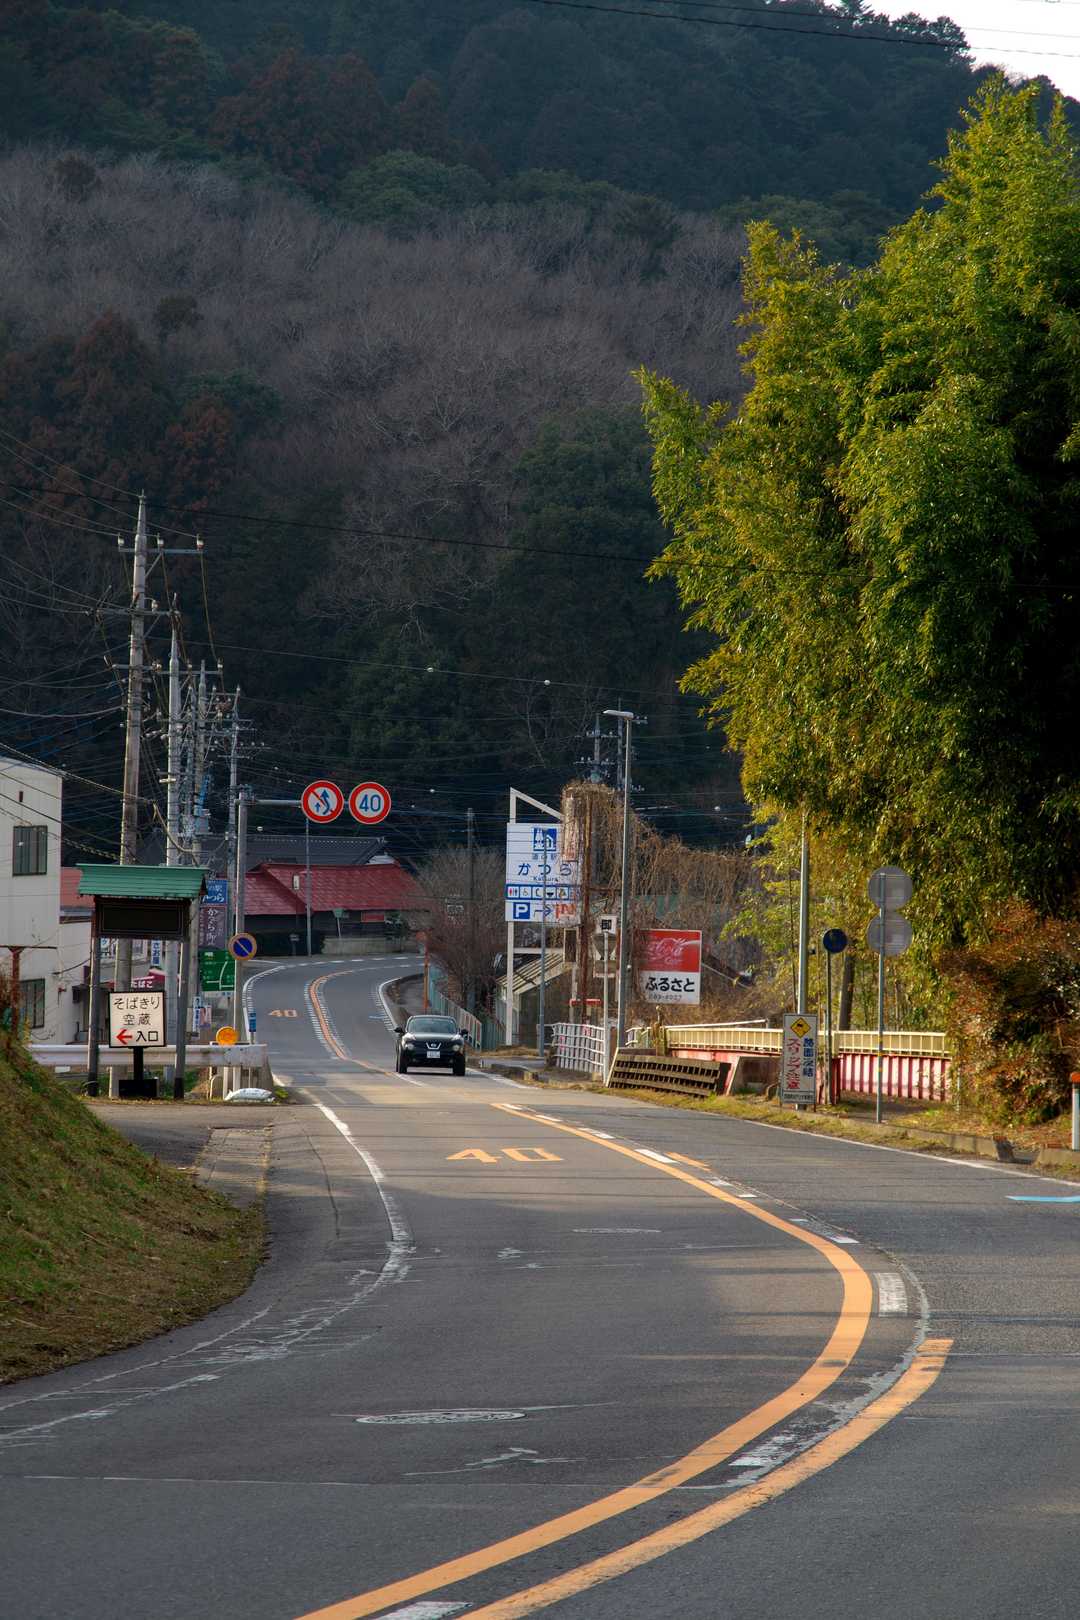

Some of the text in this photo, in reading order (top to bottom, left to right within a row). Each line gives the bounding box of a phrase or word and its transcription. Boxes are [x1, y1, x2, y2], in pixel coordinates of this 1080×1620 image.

[359, 794, 381, 812] 40
[518, 863, 572, 876] かつら
[515, 903, 528, 918] P
[645, 976, 695, 992] ふるさと
[114, 996, 160, 1010] そばきり
[123, 1013, 152, 1026] 空蔵
[268, 1009, 297, 1018] 40
[136, 1031, 159, 1042] 入口
[446, 1147, 564, 1162] 40
